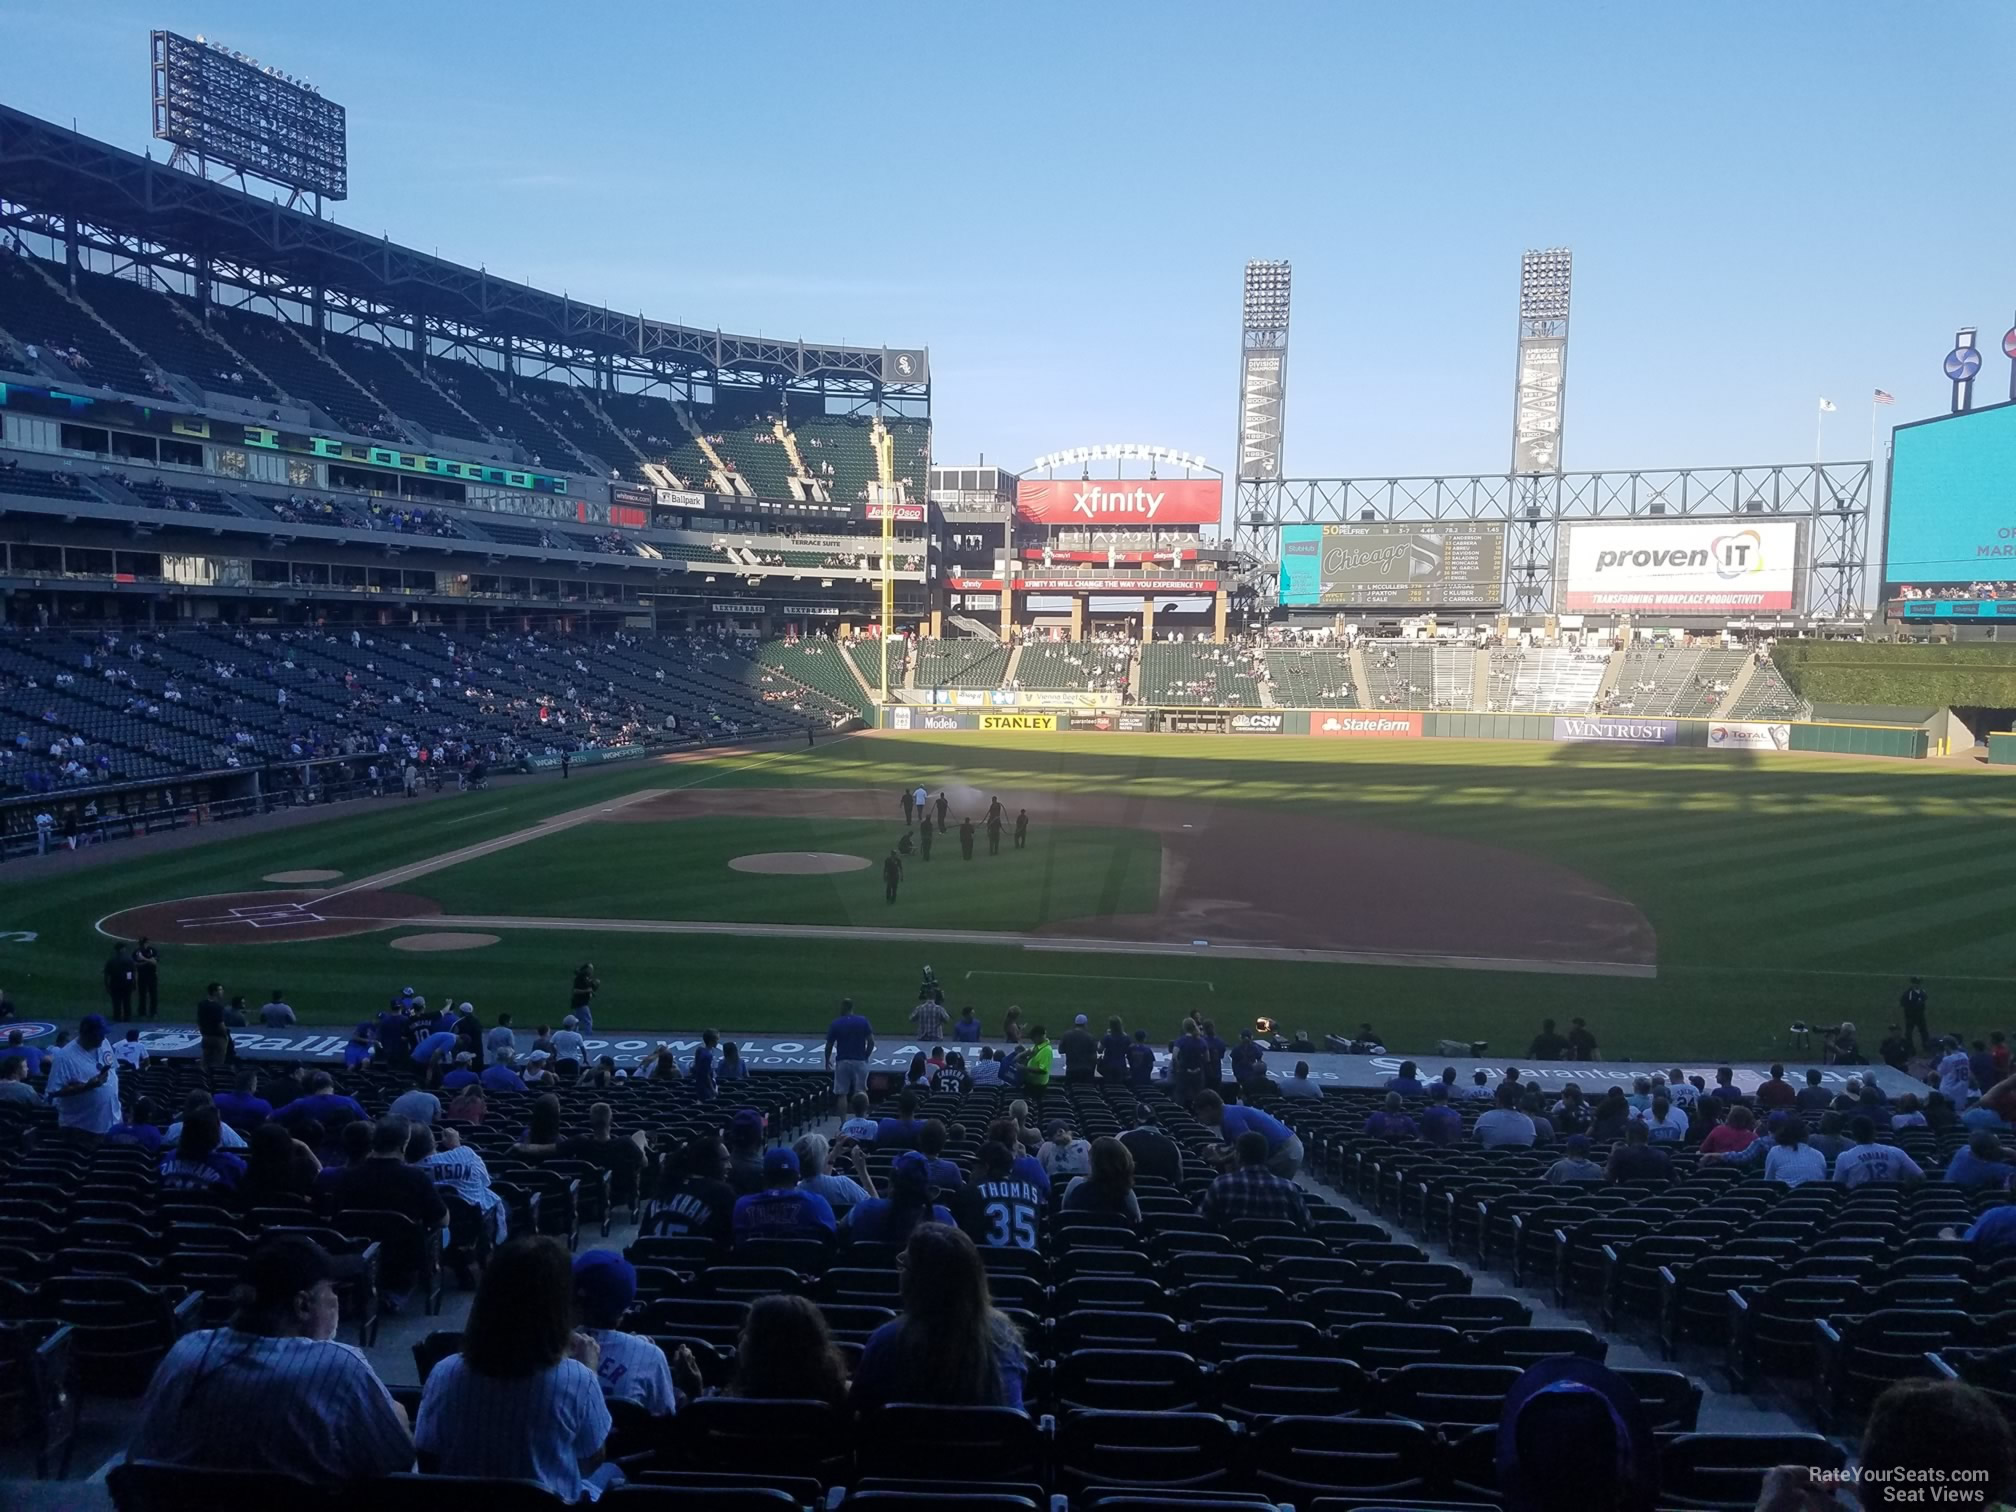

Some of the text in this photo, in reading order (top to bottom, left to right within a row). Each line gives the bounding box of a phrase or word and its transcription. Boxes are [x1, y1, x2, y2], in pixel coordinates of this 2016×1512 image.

[1035, 444, 1206, 472] FUNDAMENTALS
[672, 494, 700, 505] Ballpark
[1072, 487, 1165, 518] xfinity
[1323, 525, 1338, 534] 50
[1323, 543, 1410, 575] Chicago
[1595, 544, 1750, 572] proven IT
[1977, 545, 2016, 556] MAR
[1593, 594, 1764, 604] TRANSFORMING WORKPLACE PRODUCTIVITY
[924, 717, 957, 729] Modelo
[984, 717, 1051, 729] STANLEY
[1250, 715, 1282, 726] CSN
[1563, 720, 1666, 739] WINTRUST
[229, 1034, 348, 1056] Ballp
[1474, 1068, 1670, 1083] garanteed
[941, 1079, 960, 1093] 53
[427, 1164, 472, 1181] RSON
[978, 1181, 1038, 1204] THOMAS
[984, 1202, 1036, 1249] 35
[598, 1357, 627, 1384] ER
